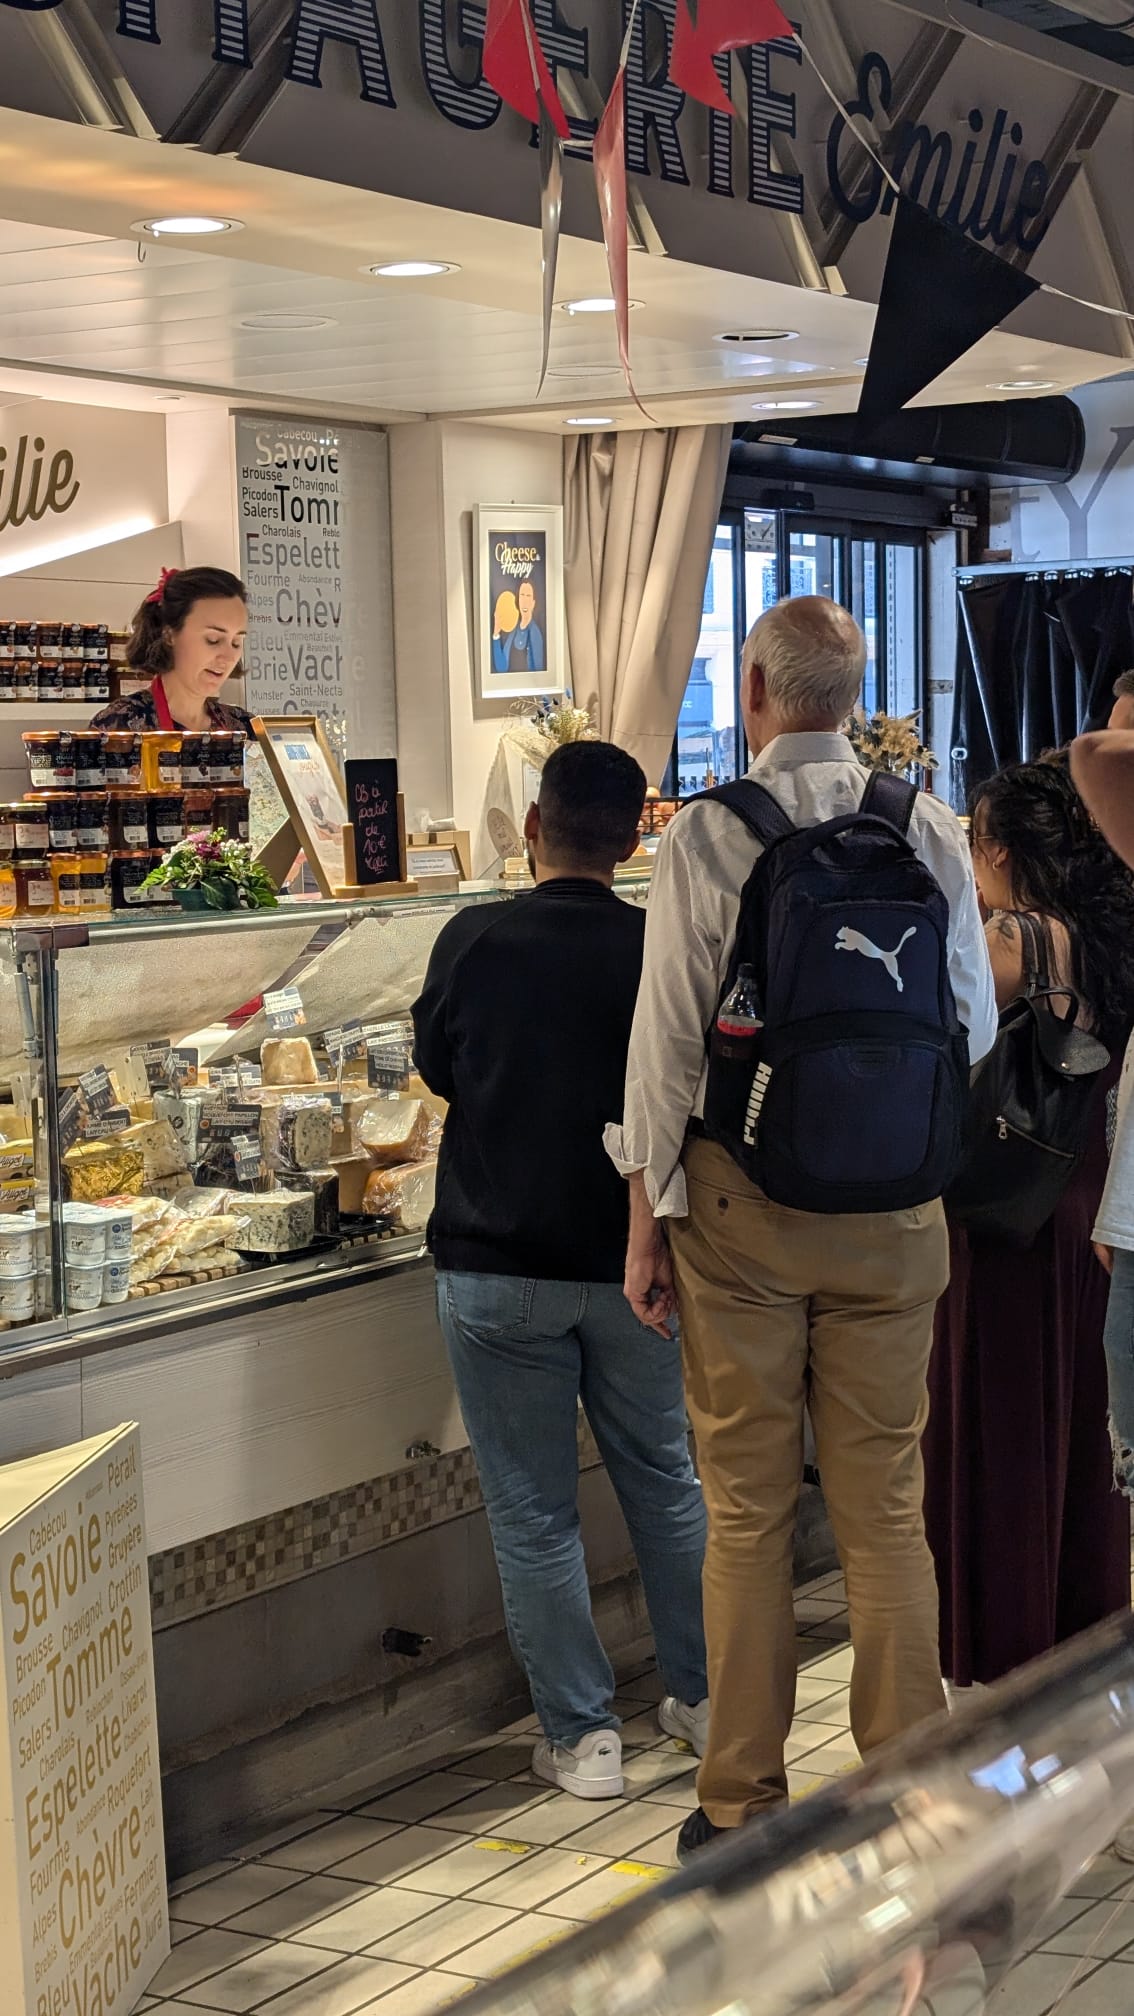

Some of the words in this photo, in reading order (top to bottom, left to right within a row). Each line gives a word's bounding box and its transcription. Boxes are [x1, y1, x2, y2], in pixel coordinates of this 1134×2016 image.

[242, 467, 283, 481] Brousse
[255, 431, 339, 474] Savoie
[242, 486, 278, 502] Picodon
[243, 501, 279, 518] Salers
[246, 533, 340, 574] Espelett
[262, 524, 302, 538] Charolais
[495, 542, 536, 562] Cheese
[247, 570, 290, 587] Fourme
[501, 548, 534, 579] Happy
[248, 630, 283, 651] Bleu
[250, 656, 287, 681] Brie
[365, 824, 379, 837] de
[108, 1445, 138, 1494] Pérail
[29, 1509, 68, 1555] Cabécou
[108, 1522, 142, 1569] Gruyère
[10, 1501, 101, 1645] Savoie
[108, 1560, 142, 1613] Crottin
[62, 1592, 103, 1651] Chavignol
[16, 1633, 54, 1684] Brousse
[46, 1606, 133, 1732] Tomme
[12, 1677, 46, 1726] Picodon
[18, 1717, 52, 1769] Salers
[39, 1730, 76, 1781] Charolais
[26, 1714, 121, 1861] Espelette
[107, 1744, 151, 1816] Roquefort
[29, 1840, 70, 1905] Fourme
[59, 1806, 141, 1950] Chèvre
[124, 1853, 158, 1915] Fermier
[32, 1903, 57, 1949] Alpes
[144, 1909, 162, 1950] Jura
[72, 1917, 142, 2016] Vache
